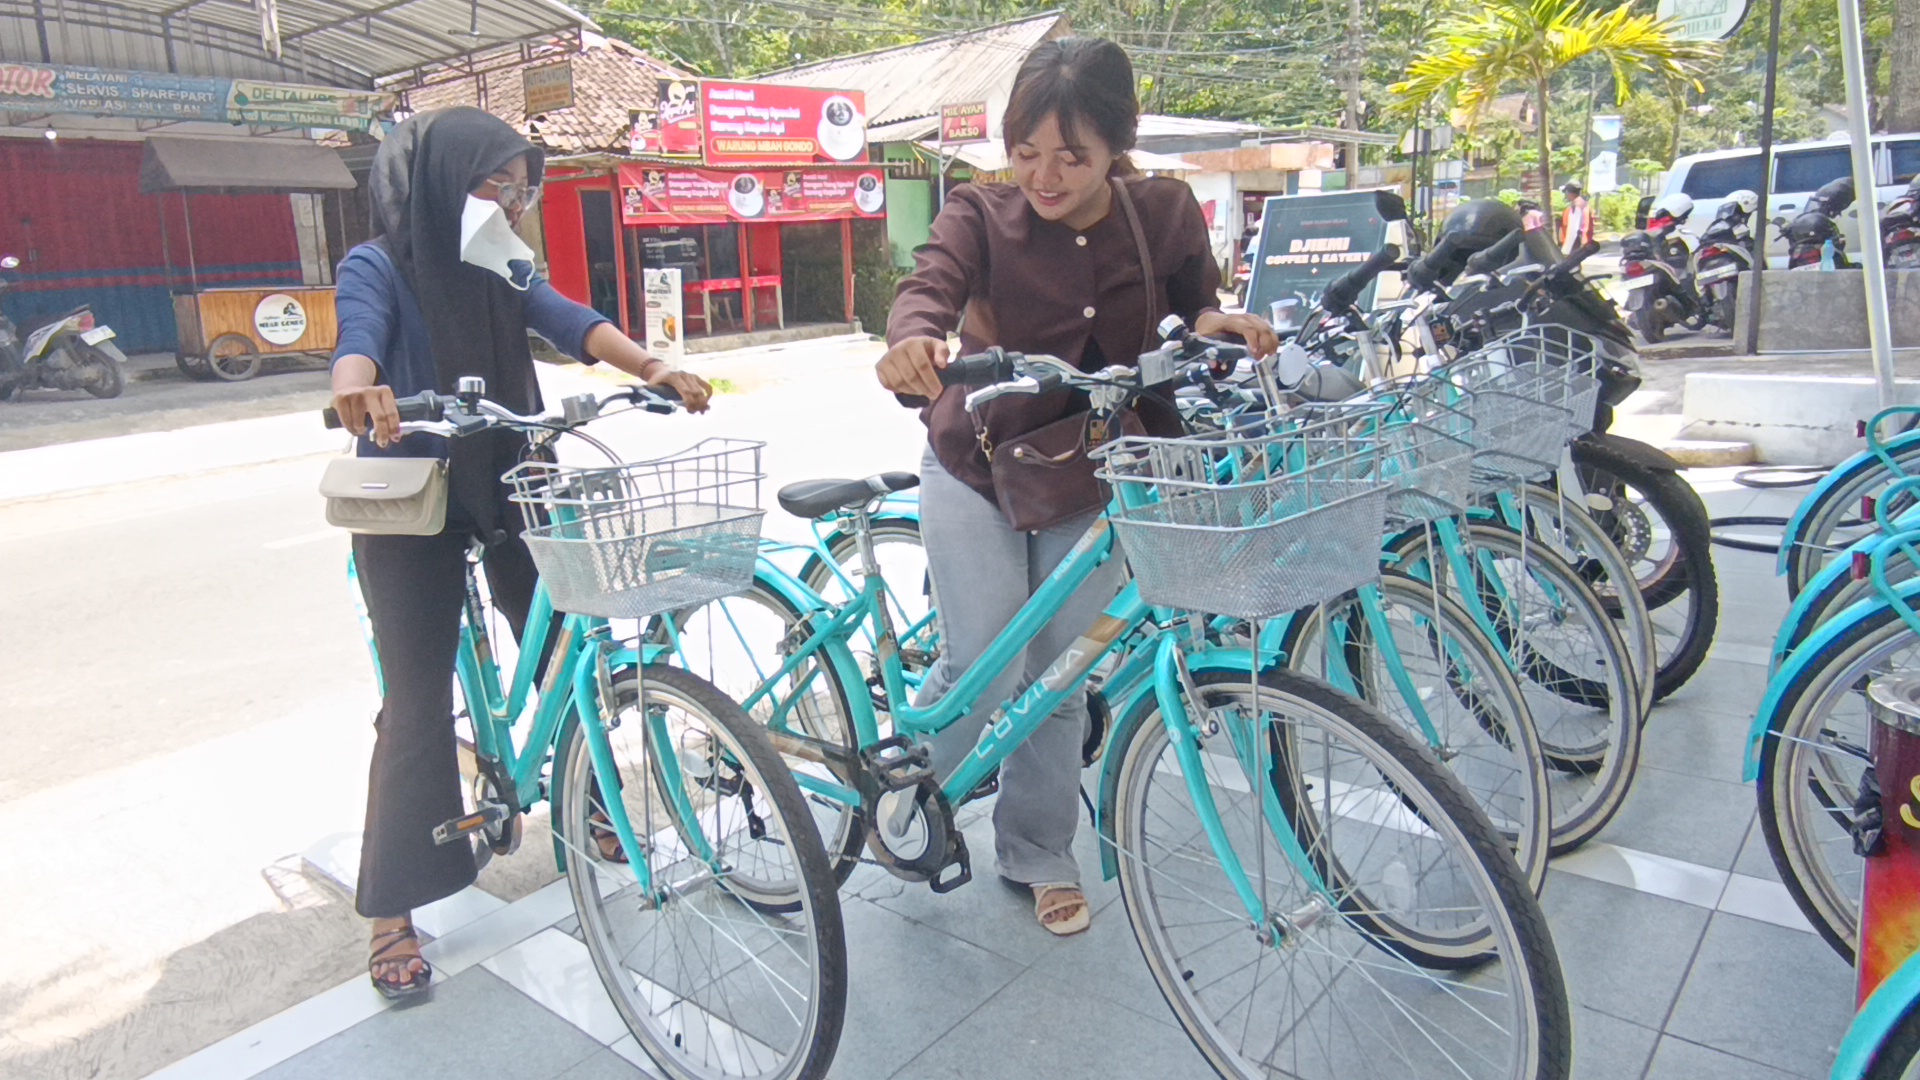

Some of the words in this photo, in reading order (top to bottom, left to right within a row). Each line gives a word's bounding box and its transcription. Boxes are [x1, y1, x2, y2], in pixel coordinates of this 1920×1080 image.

[65, 70, 128, 83] MELAYANI
[66, 83, 119, 97] SERVIS
[131, 88, 176, 100] SPARE
[180, 90, 214, 102] PART
[173, 103, 201, 114] BAN
[943, 106, 959, 117] MIE
[960, 103, 984, 115] AYAM
[293, 114, 331, 125] TAHAN
[948, 126, 979, 138] BAKSO
[716, 139, 757, 153] WARUNG
[1289, 237, 1351, 253] DJIEMI
[1265, 254, 1310, 265] COFFEE
[1310, 254, 1320, 264] &
[1321, 252, 1371, 263] EATERY
[975, 648, 1085, 760] LOVINA
